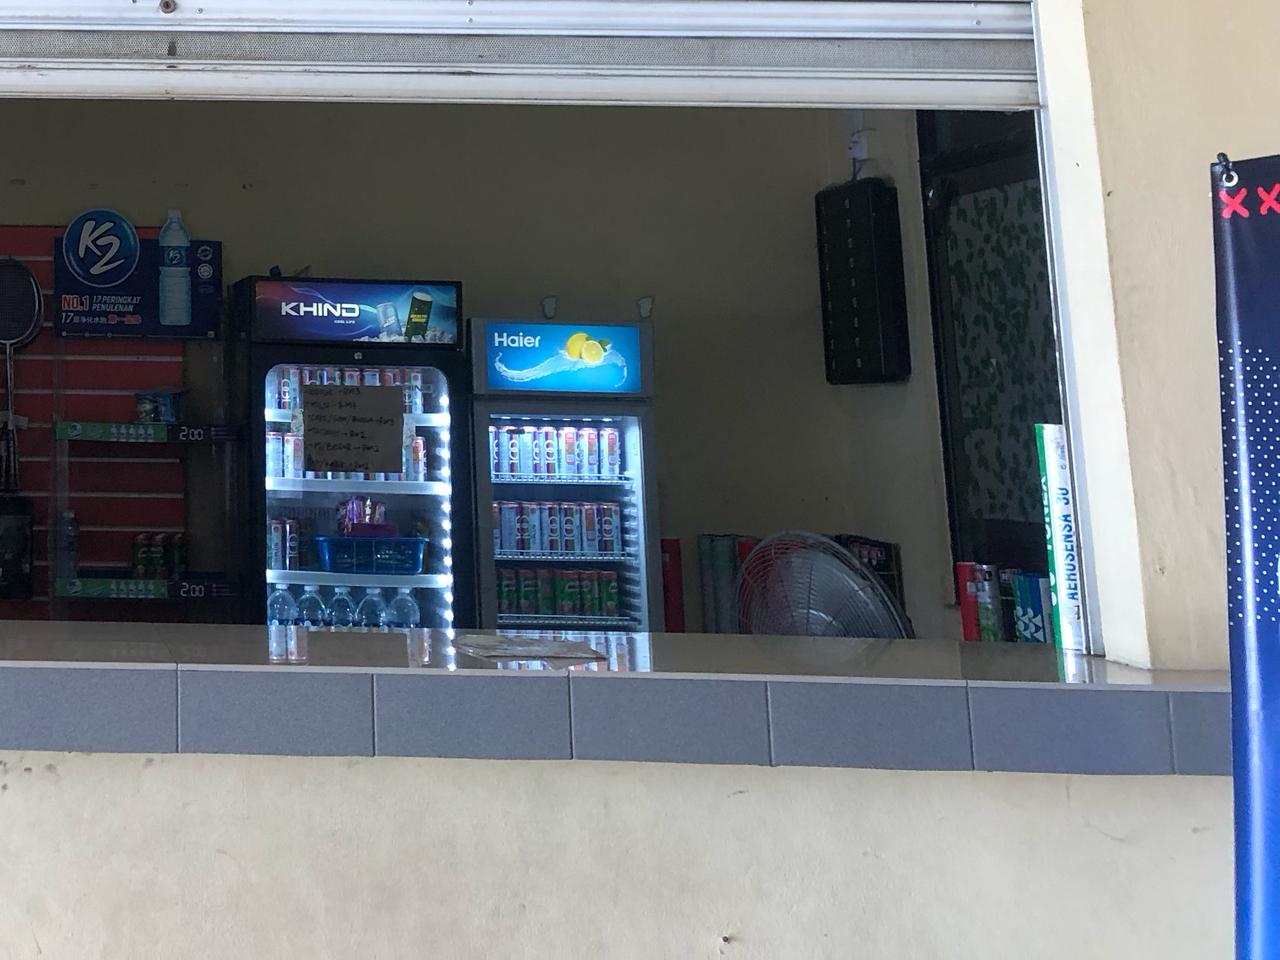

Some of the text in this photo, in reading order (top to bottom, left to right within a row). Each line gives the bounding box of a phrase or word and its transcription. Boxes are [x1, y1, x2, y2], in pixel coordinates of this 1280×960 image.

[78, 219, 127, 275] K2
[281, 302, 360, 317] KHIND
[494, 332, 540, 347] Haier
